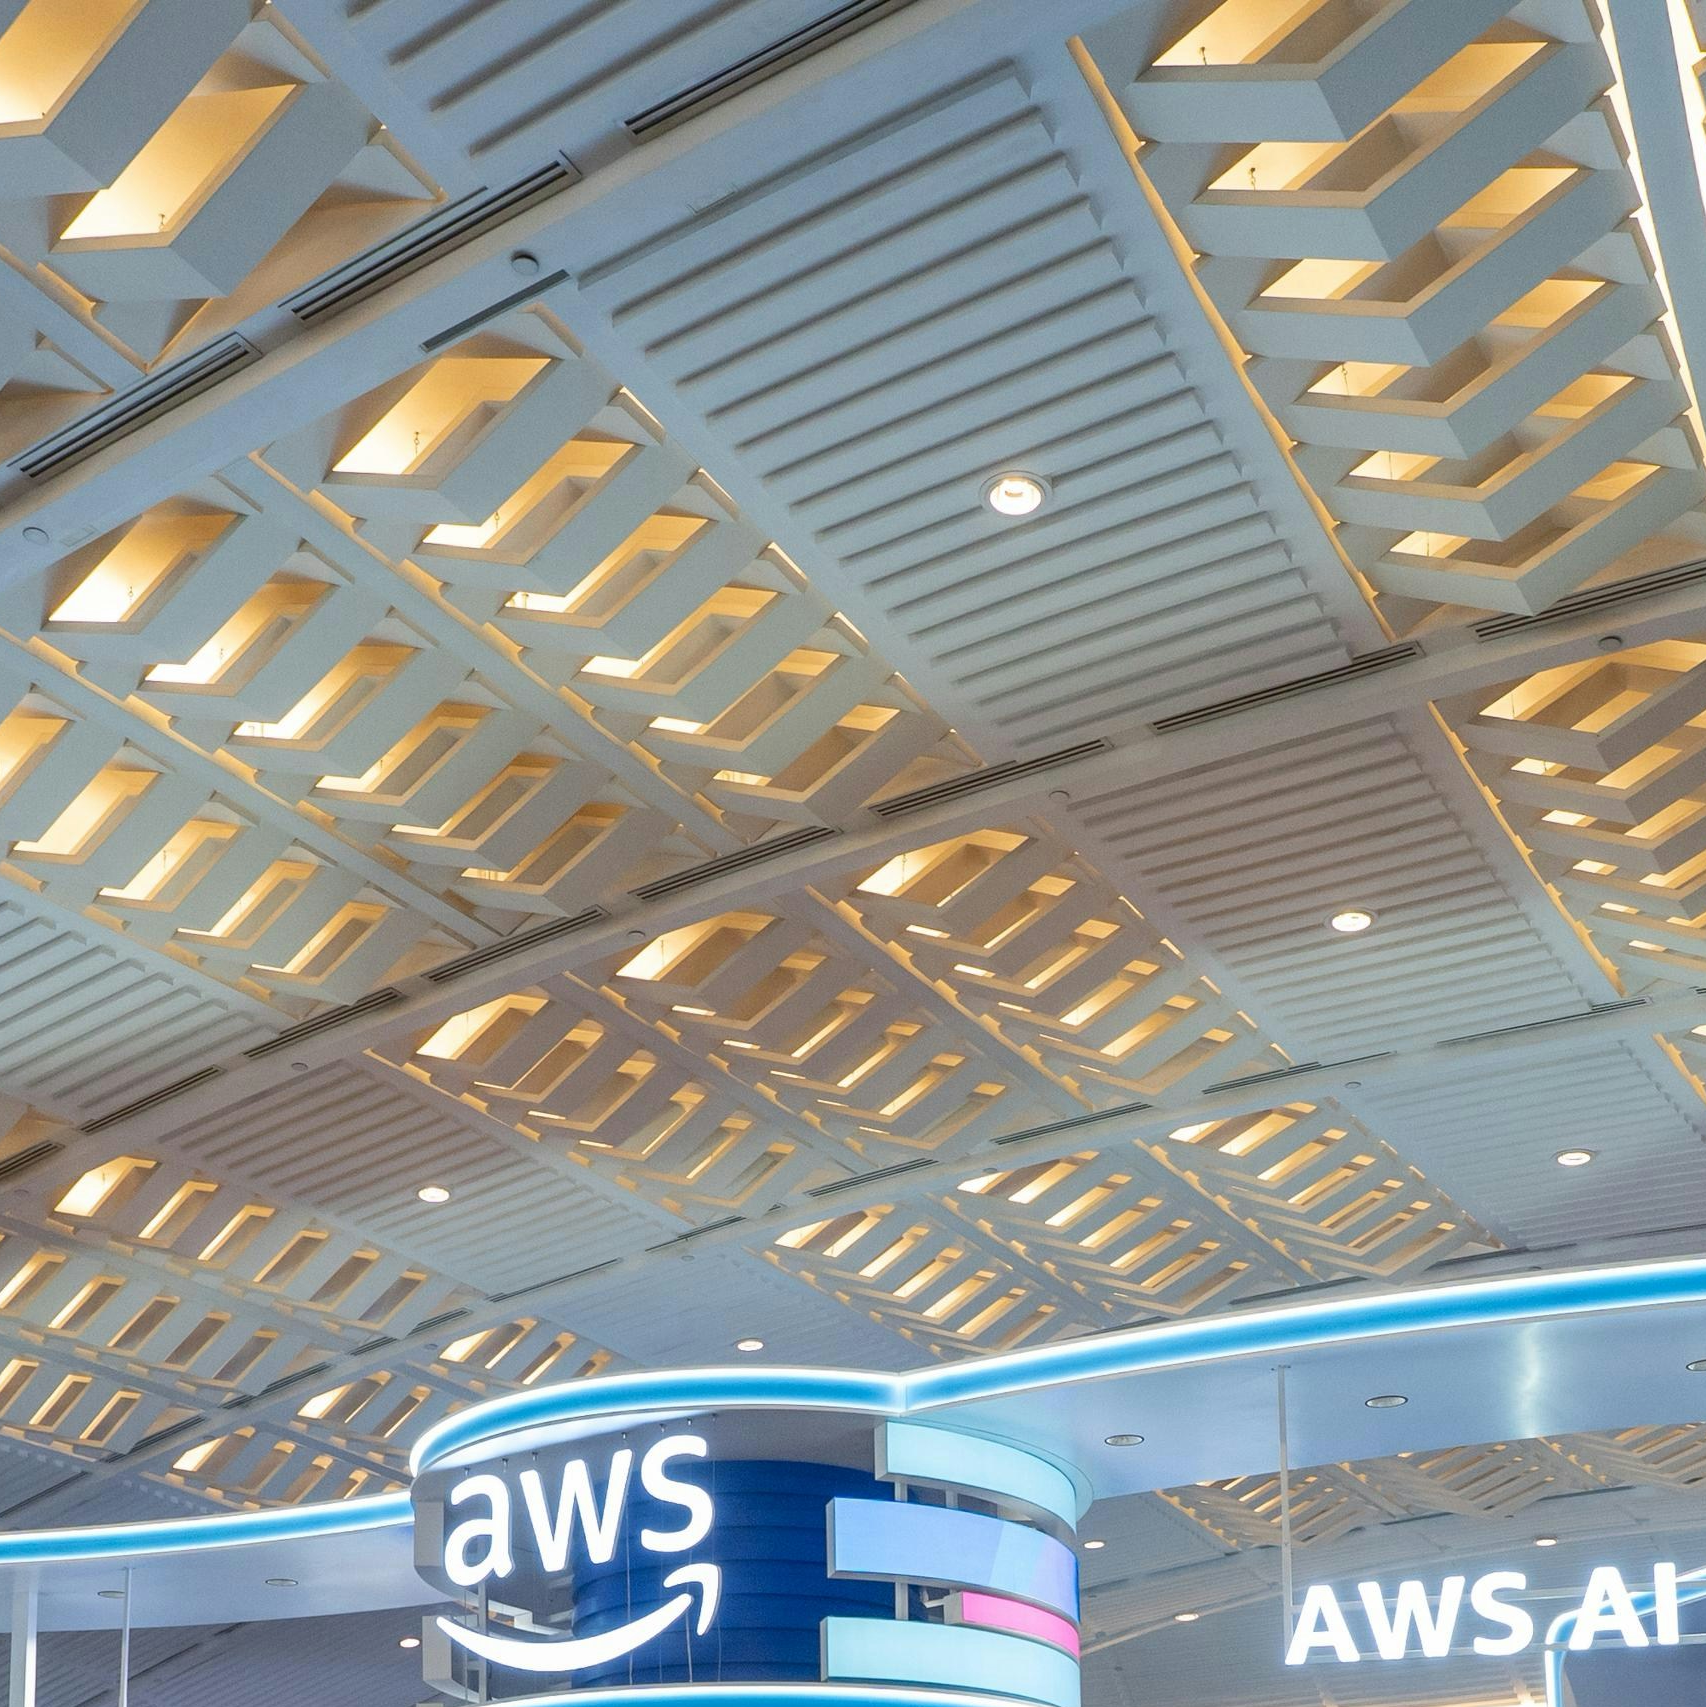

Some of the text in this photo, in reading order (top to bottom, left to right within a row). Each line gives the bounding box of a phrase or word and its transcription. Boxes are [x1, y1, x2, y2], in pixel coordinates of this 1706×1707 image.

[444, 1434, 715, 1588] aws
[1284, 1570, 1534, 1666] AWS
[1568, 1562, 1680, 1651] AI
